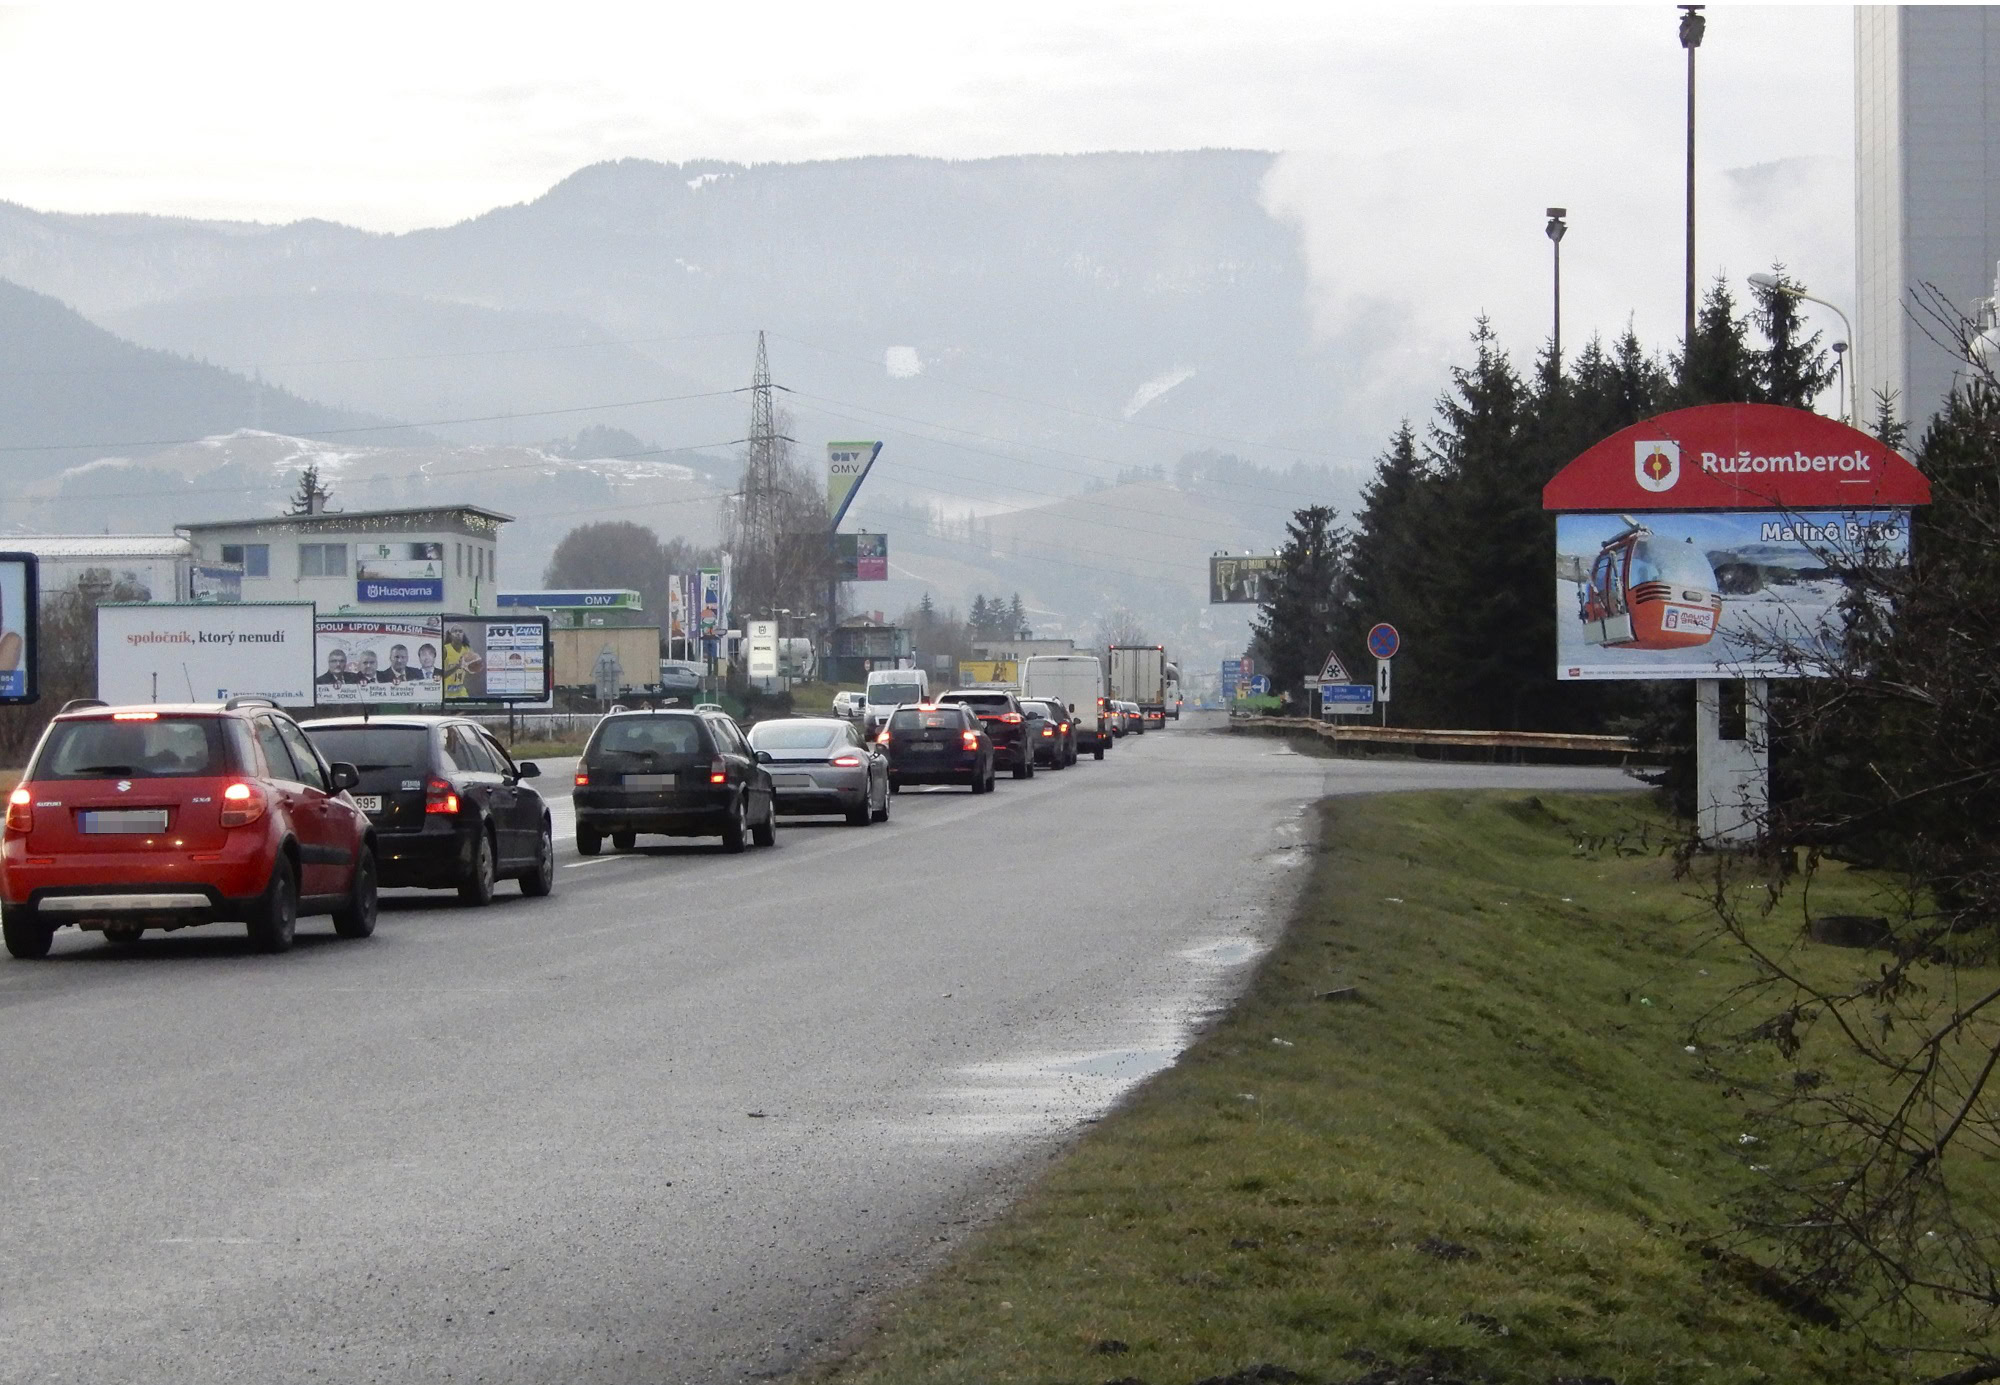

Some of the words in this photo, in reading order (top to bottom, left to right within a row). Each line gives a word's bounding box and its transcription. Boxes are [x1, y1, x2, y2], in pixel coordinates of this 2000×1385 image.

[1701, 450, 1870, 473] Ružomberok
[831, 464, 860, 474] OMV
[1761, 521, 1839, 542] Malinô
[379, 586, 432, 597] Husqvarna
[584, 596, 612, 605] OMV
[349, 623, 380, 633] LIPTOV
[127, 631, 196, 647] spoločník,
[199, 631, 235, 646] ktorý
[239, 631, 285, 643] nenudí
[356, 797, 376, 809] 695
